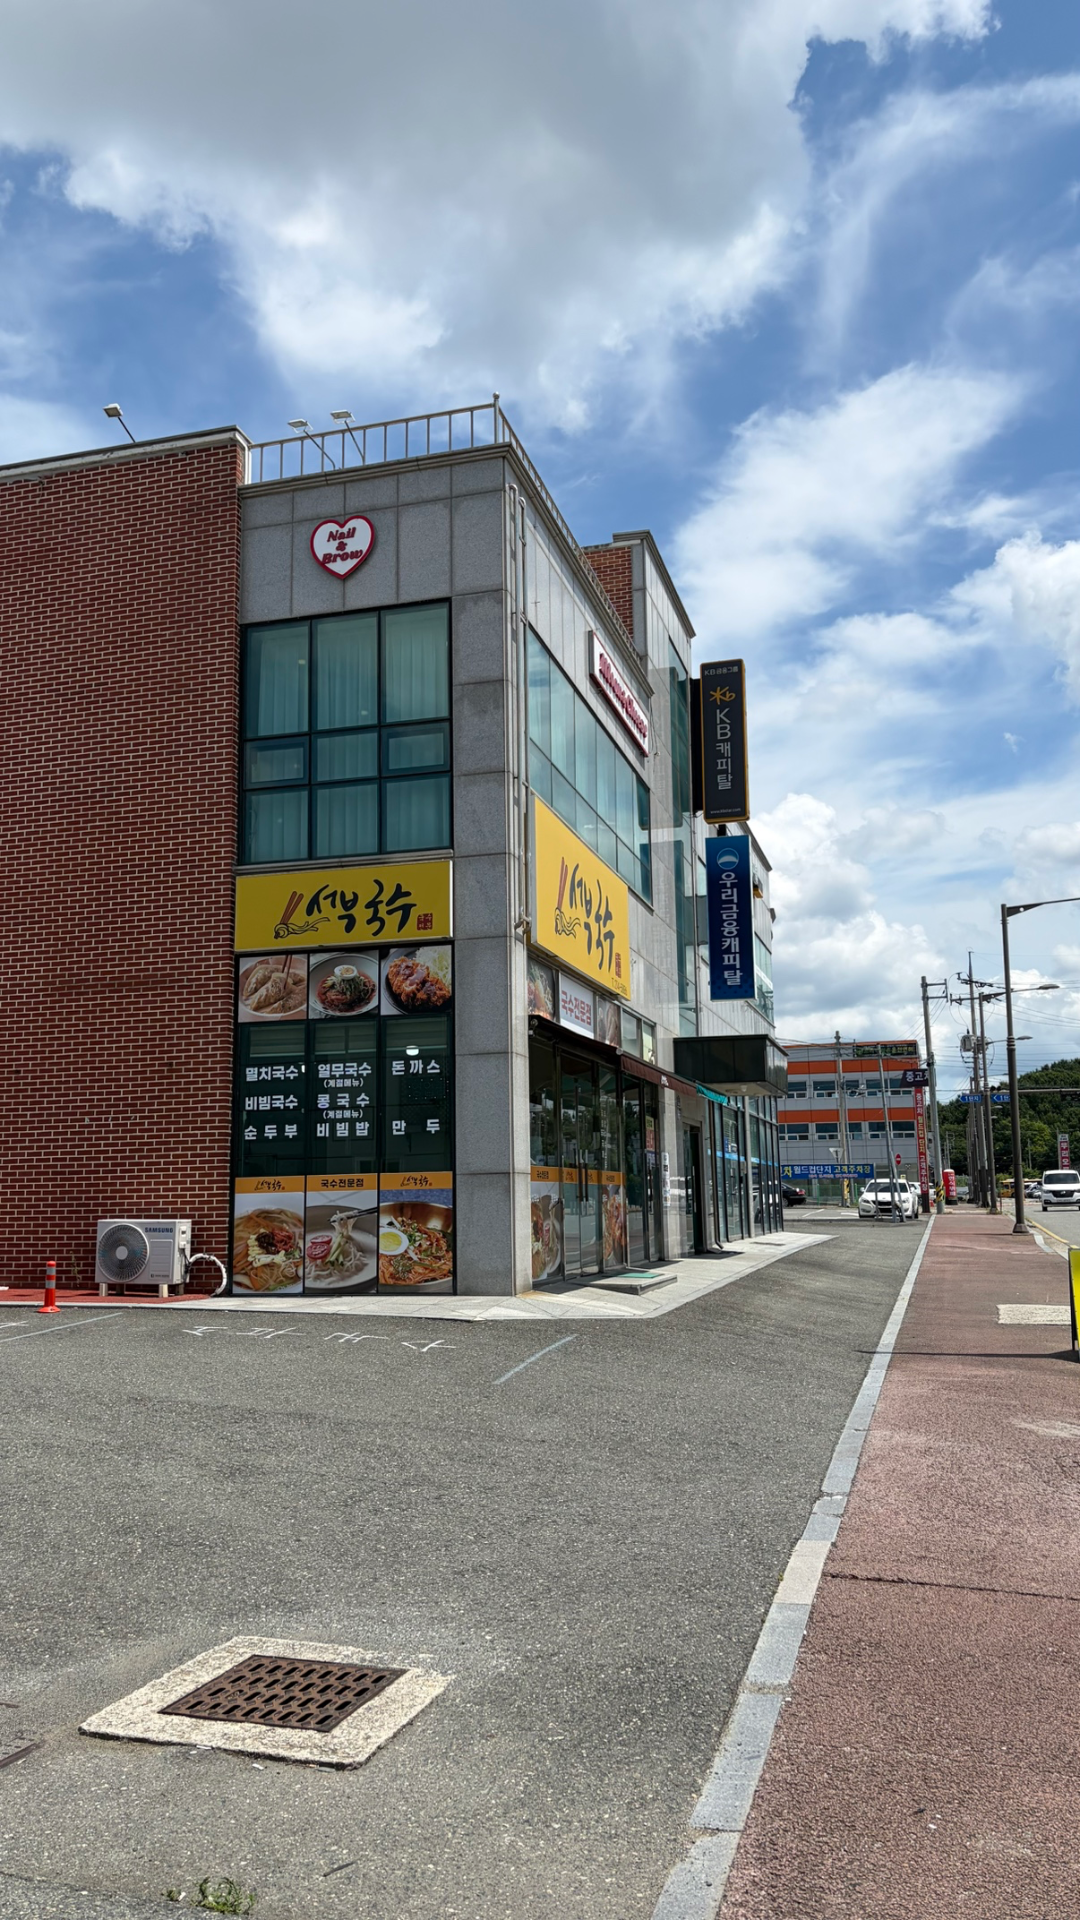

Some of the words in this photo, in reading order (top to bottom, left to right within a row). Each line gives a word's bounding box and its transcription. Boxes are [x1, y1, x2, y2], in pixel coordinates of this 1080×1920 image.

[326, 526, 357, 542] Nail
[335, 541, 348, 552] &
[321, 549, 364, 564] Brow
[715, 707, 733, 790] KB캐피탈
[719, 871, 743, 986] 우리금융캐피탈
[561, 990, 592, 1026] 국수전문점
[245, 1065, 299, 1082] 멸치국수
[317, 1062, 372, 1078] 열무국수
[391, 1059, 441, 1076] 돈까스
[244, 1095, 298, 1111] 비빔국수
[793, 1165, 832, 1175] 월드컵단지
[833, 1165, 871, 1174] 고객주차장
[320, 1178, 364, 1188] 국수전문점
